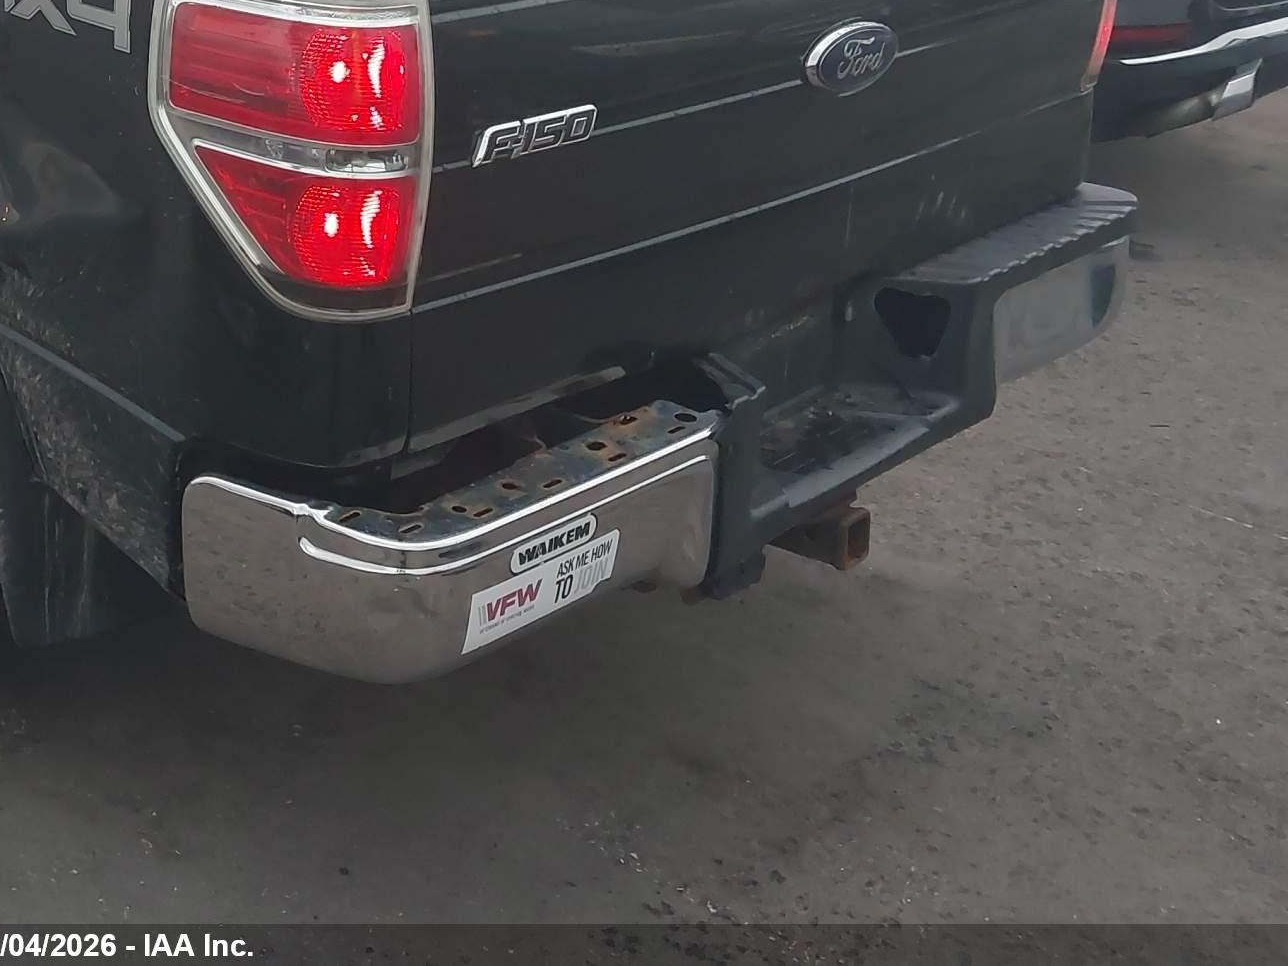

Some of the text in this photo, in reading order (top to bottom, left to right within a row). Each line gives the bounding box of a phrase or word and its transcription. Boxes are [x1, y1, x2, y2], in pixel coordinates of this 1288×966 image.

[837, 36, 886, 79] Ford
[472, 104, 598, 168] F-150
[518, 521, 591, 566] WAIKEM
[557, 538, 614, 578] ASK ME HOW
[486, 577, 543, 622] VFW
[554, 574, 574, 604] TO
